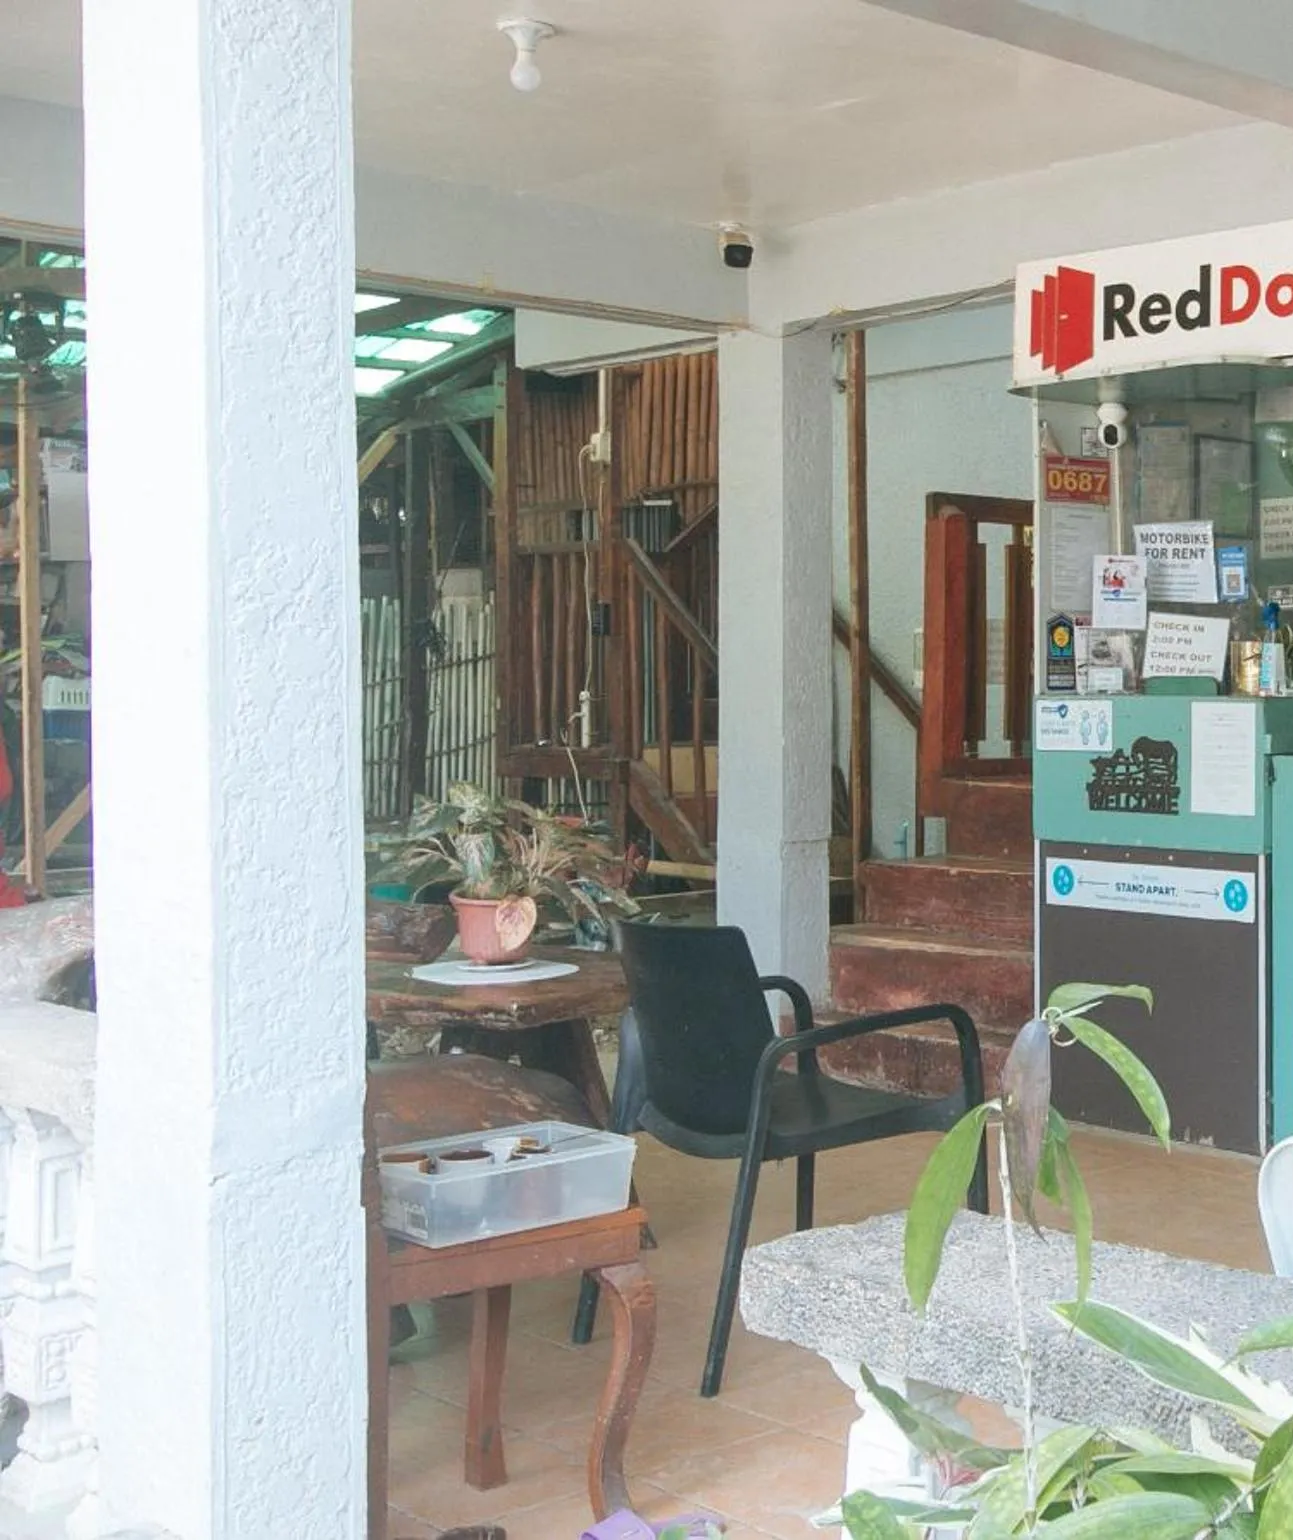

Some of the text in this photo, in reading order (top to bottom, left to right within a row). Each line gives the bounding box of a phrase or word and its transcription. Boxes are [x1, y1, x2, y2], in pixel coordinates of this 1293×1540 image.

[1047, 470, 1108, 493] 0687
[1140, 532, 1209, 545] MOTORBIKE
[1145, 547, 1206, 560] FOR RENT
[1153, 621, 1205, 632] CHECK IN
[1150, 651, 1212, 662] CHECK OUT
[1089, 789, 1180, 815] WELCOME
[1115, 882, 1145, 894] STAND
